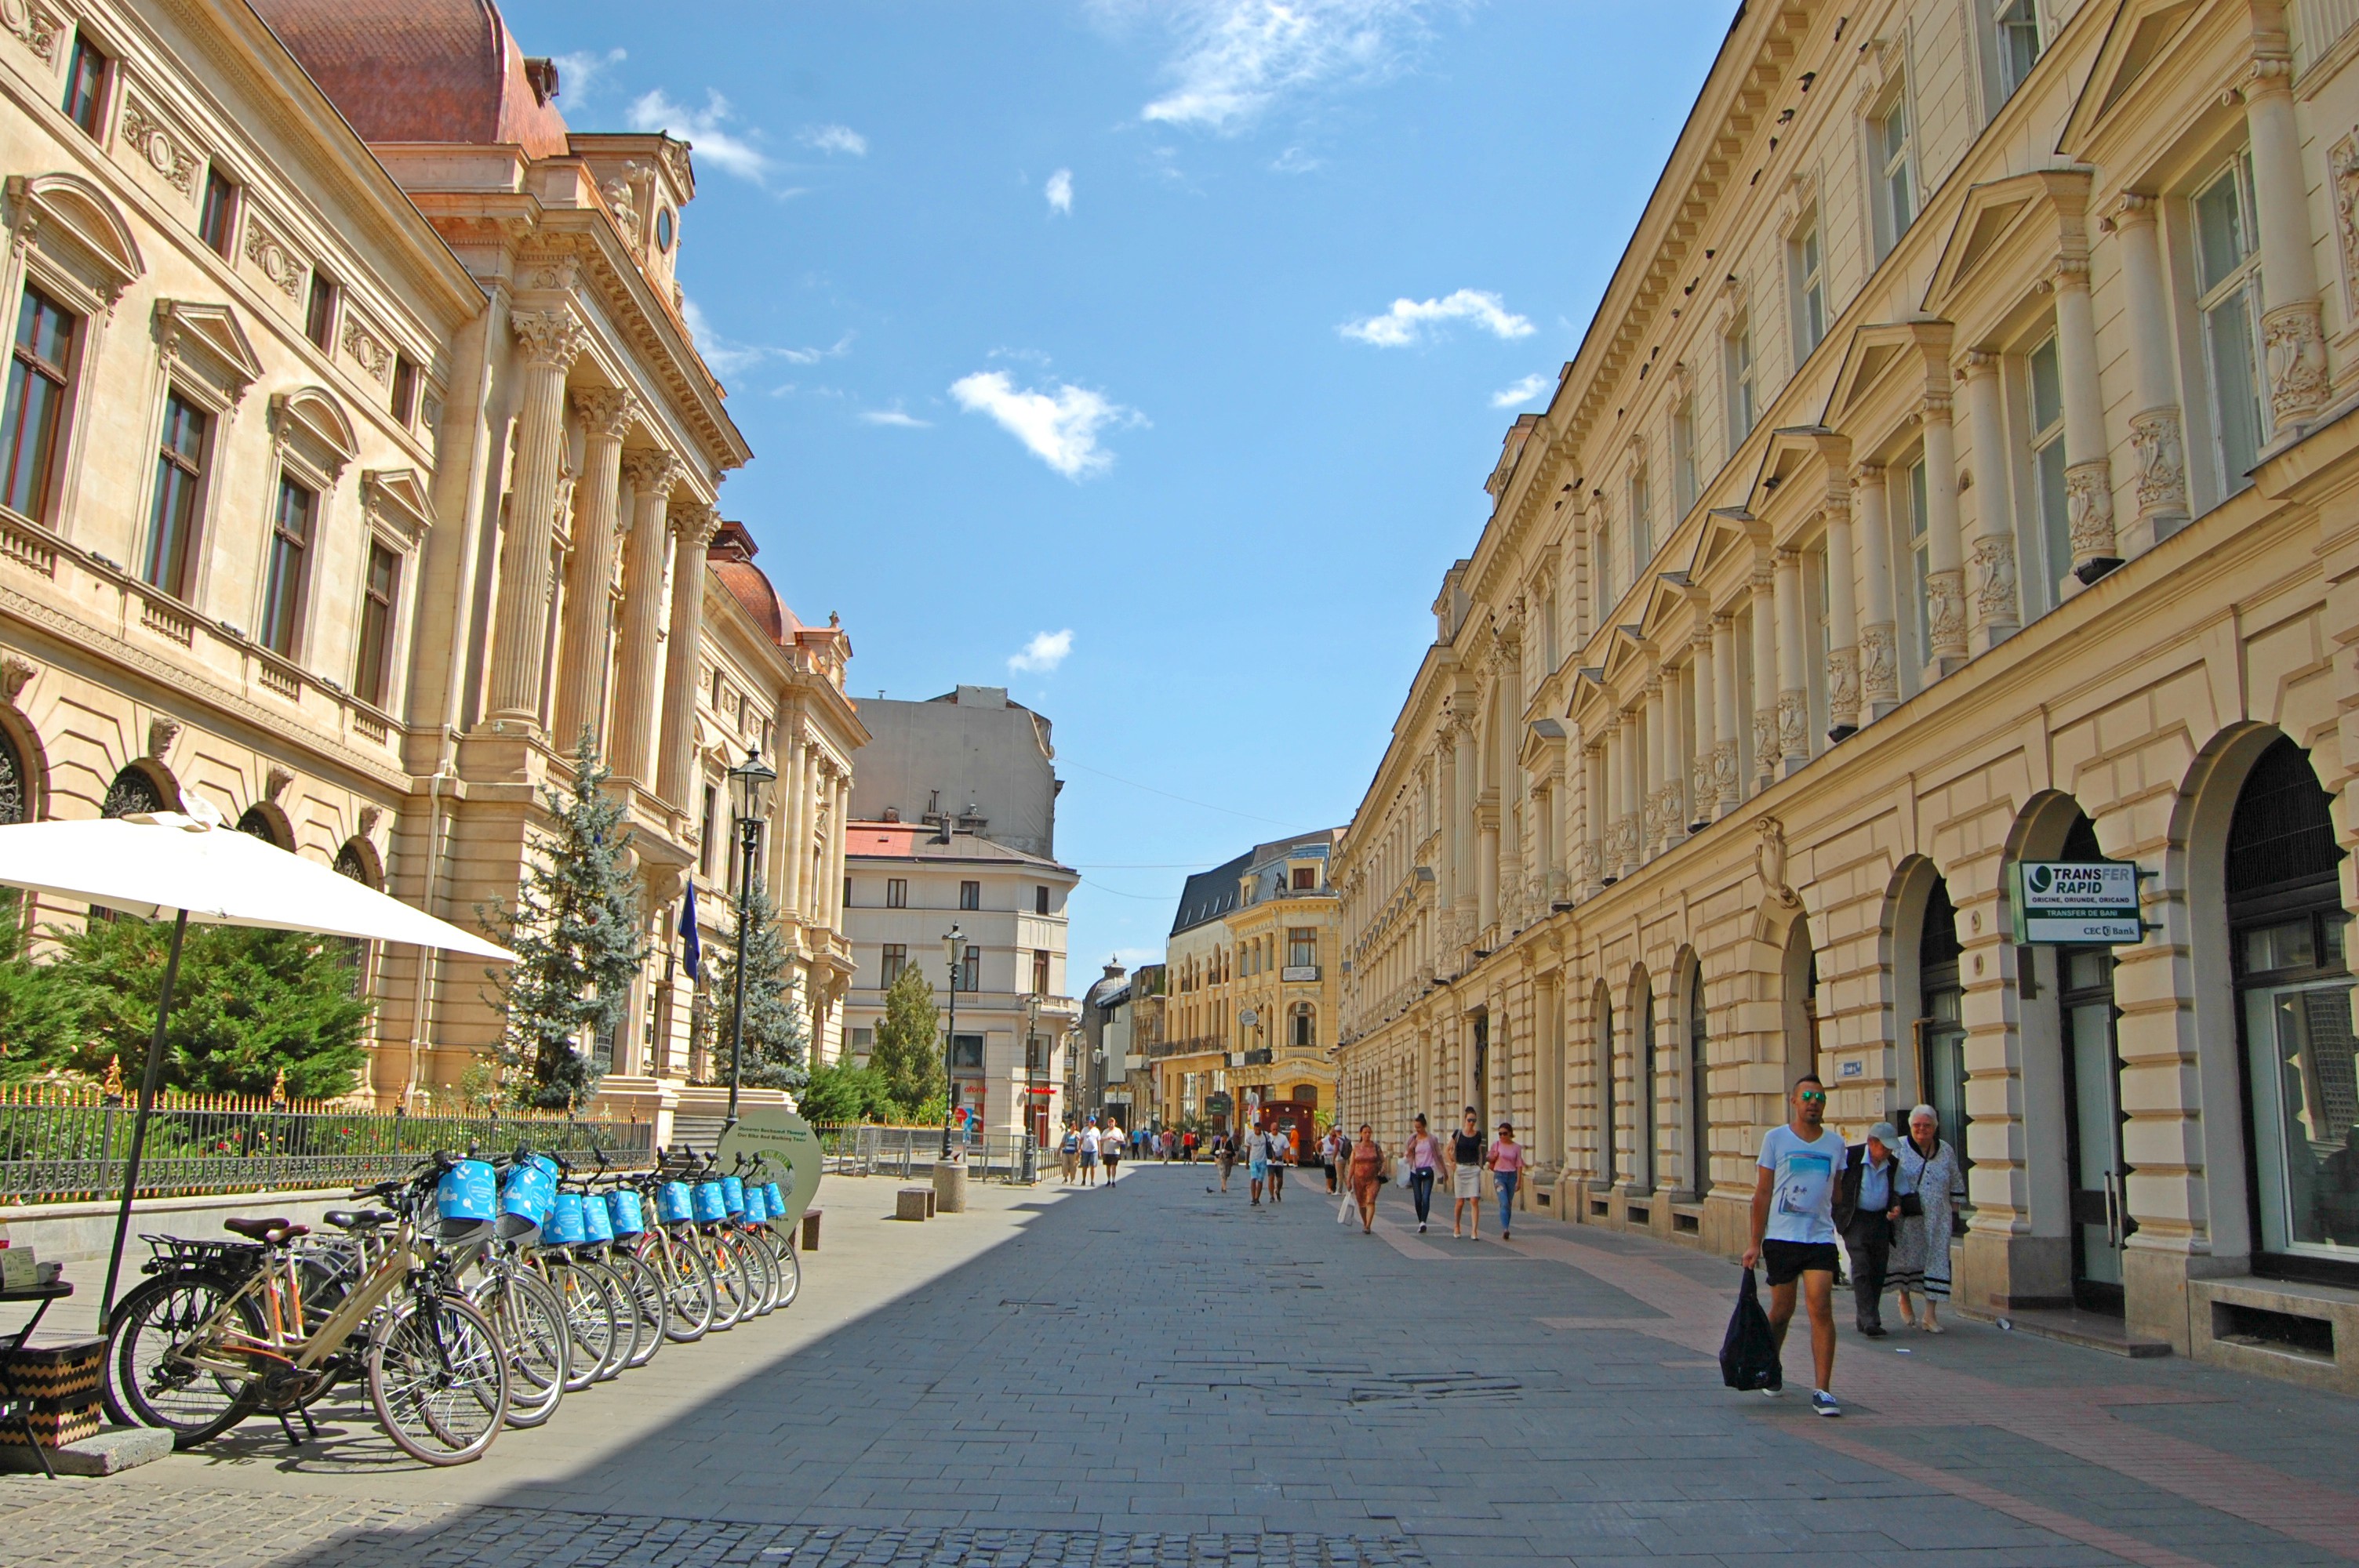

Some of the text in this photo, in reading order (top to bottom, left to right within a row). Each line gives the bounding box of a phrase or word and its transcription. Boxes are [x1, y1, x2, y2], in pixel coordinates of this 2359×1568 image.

[2053, 868, 2129, 880] TRANSFER
[2055, 882, 2103, 894] RAPID
[2083, 926, 2135, 935] CEC Bank
